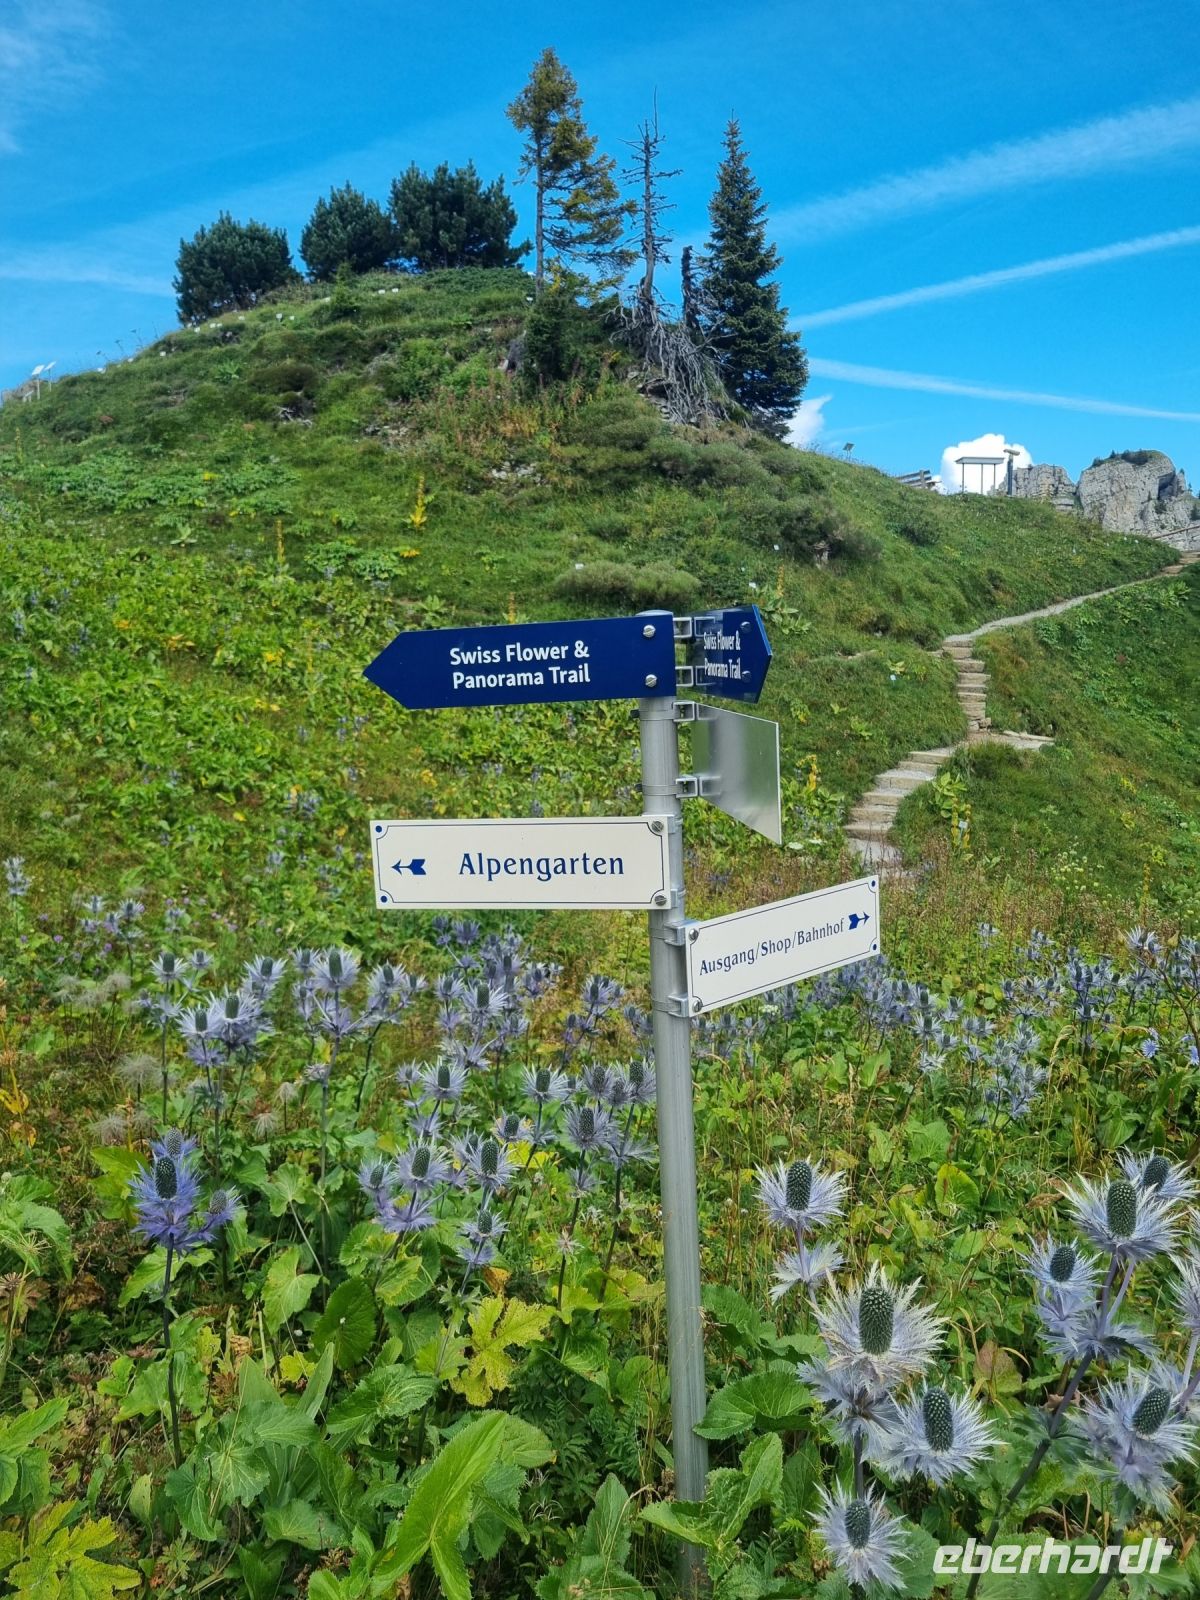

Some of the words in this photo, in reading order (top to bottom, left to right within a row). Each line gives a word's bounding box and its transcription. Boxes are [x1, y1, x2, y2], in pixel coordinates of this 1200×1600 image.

[450, 646, 501, 666] Swiss
[506, 641, 569, 663] Flower
[574, 640, 590, 658] &
[703, 632, 717, 650] Swiss
[717, 630, 735, 650] Flower
[735, 630, 741, 651] &
[452, 669, 545, 689] Panorama
[548, 664, 591, 684] Trail
[704, 657, 728, 678] Panorama
[728, 657, 742, 680] Trail
[459, 852, 625, 882] Alpengarten
[699, 917, 845, 976] Ausgang/Shop/Bahnhof
